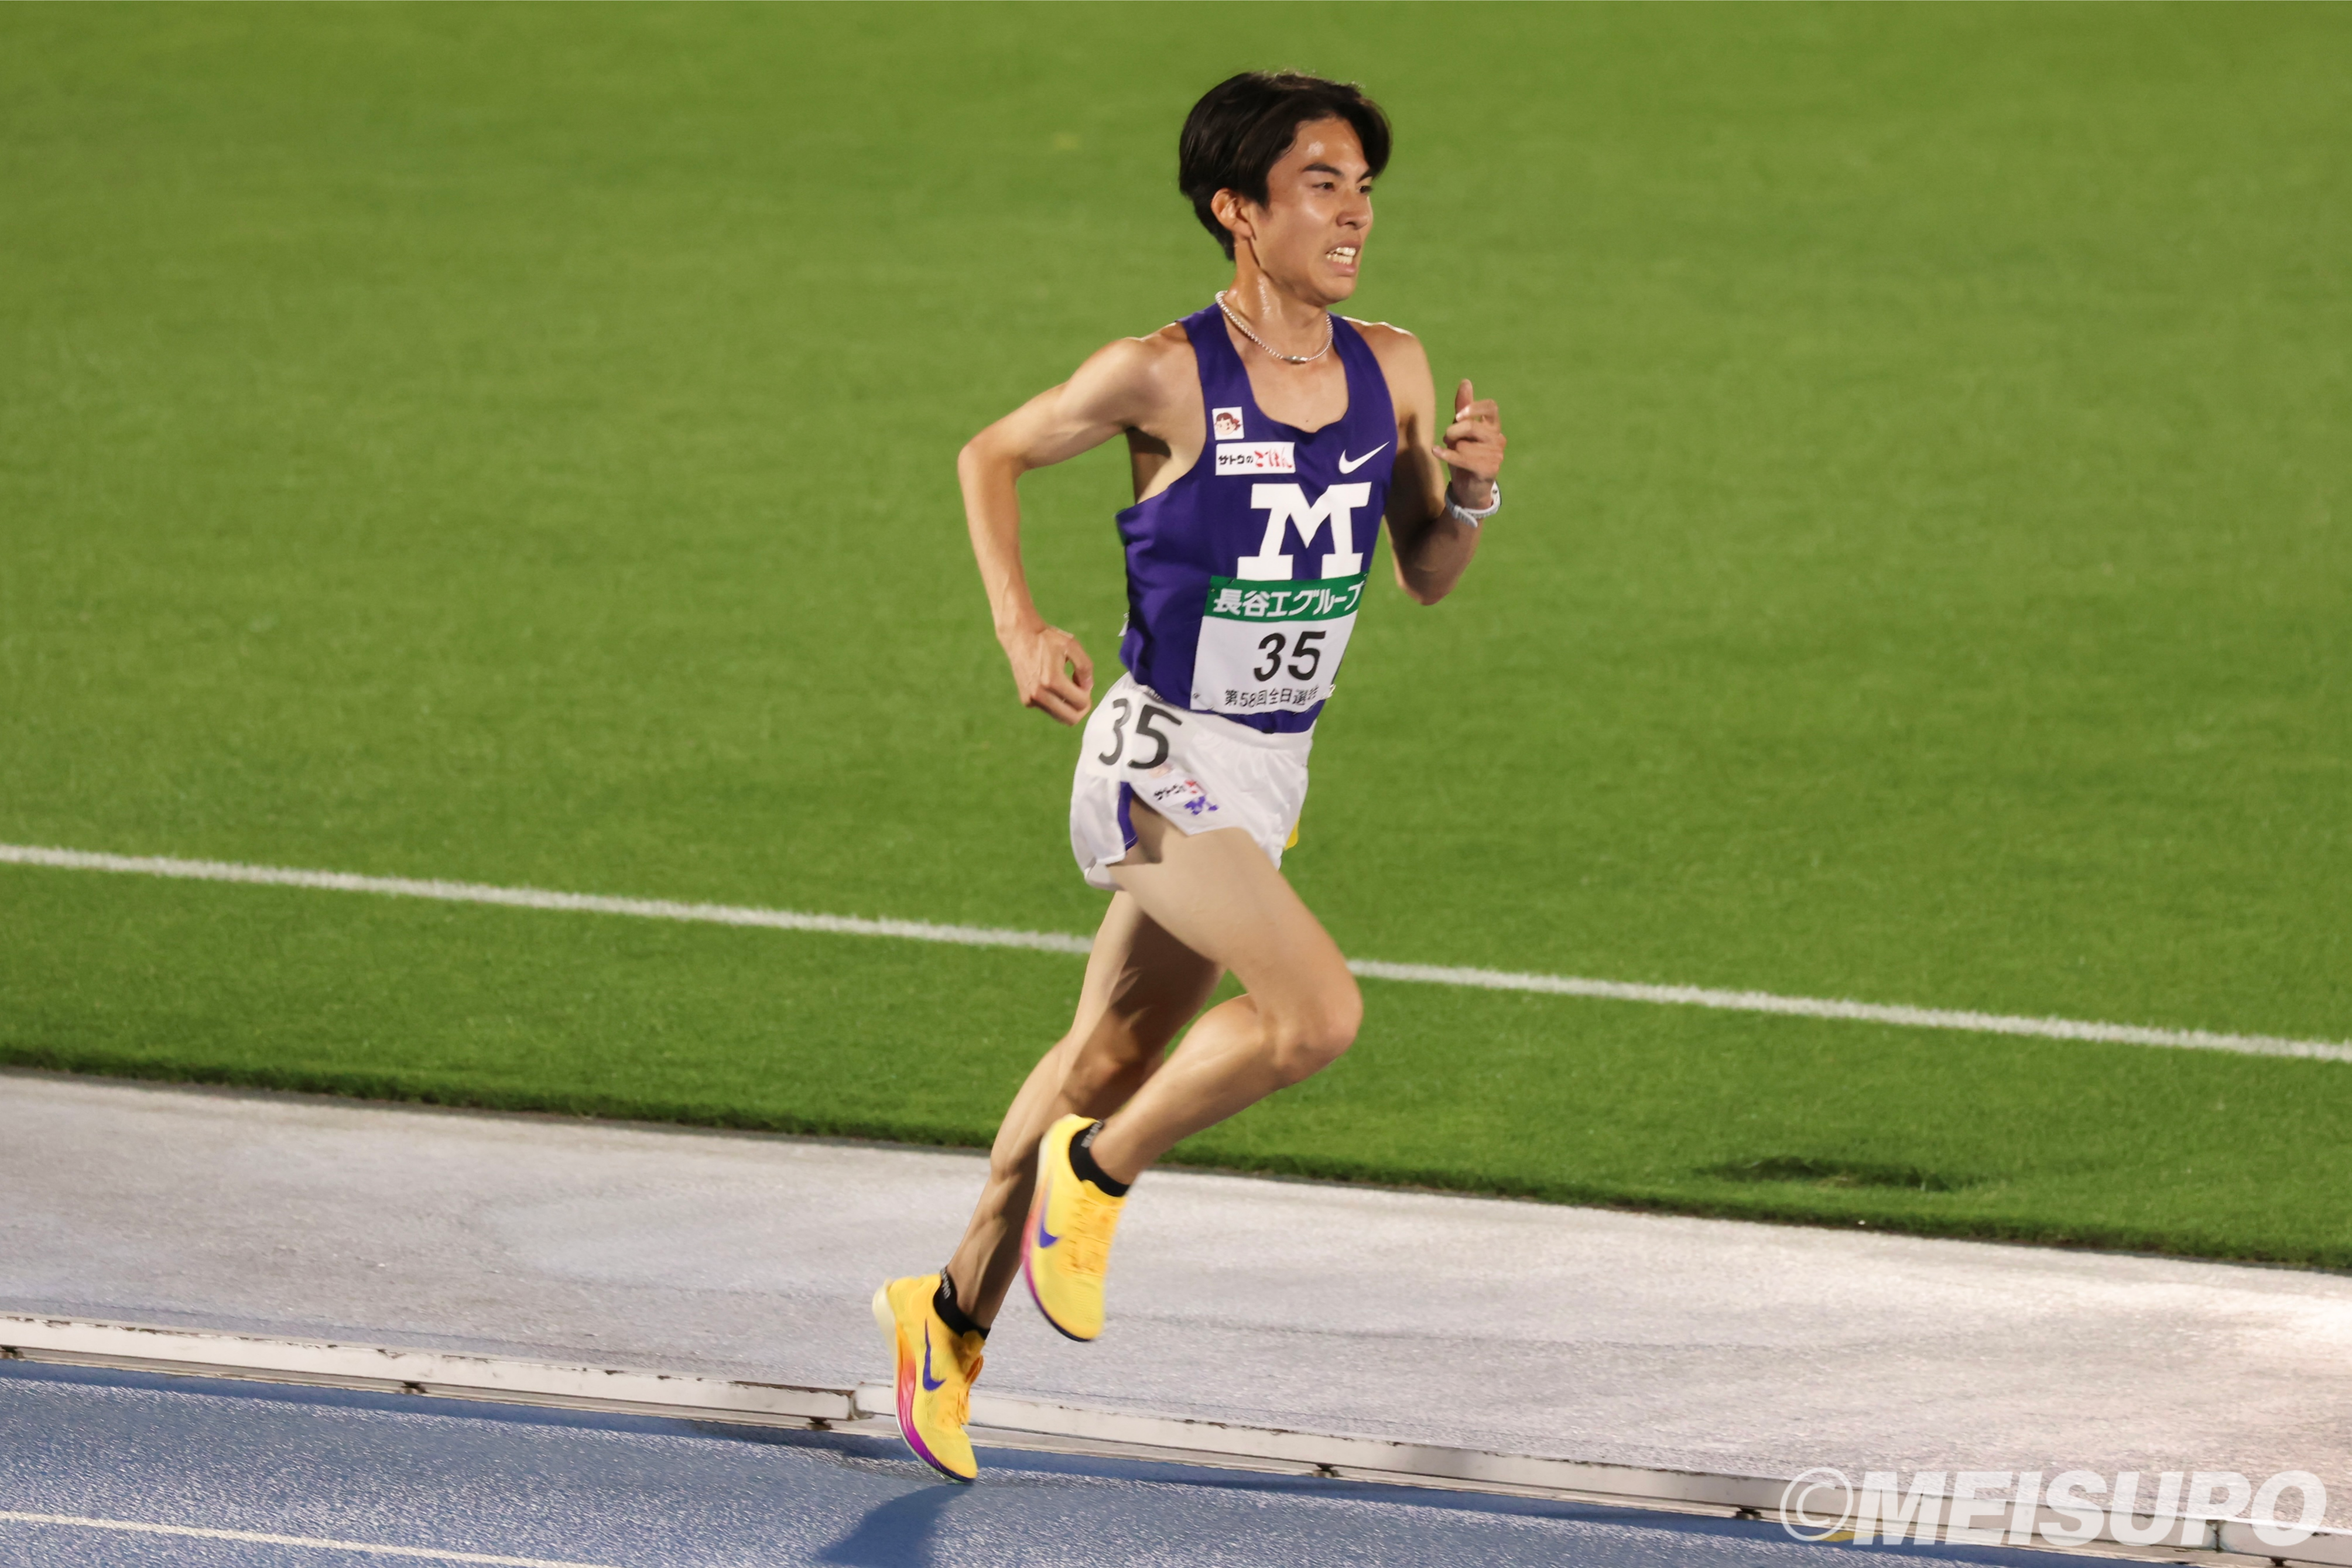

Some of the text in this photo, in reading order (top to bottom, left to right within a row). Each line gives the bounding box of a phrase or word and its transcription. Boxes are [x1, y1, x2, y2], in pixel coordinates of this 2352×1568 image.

[1236, 481, 1372, 581] M
[1253, 630, 1327, 682] 35
[1098, 697, 1183, 770] 35
